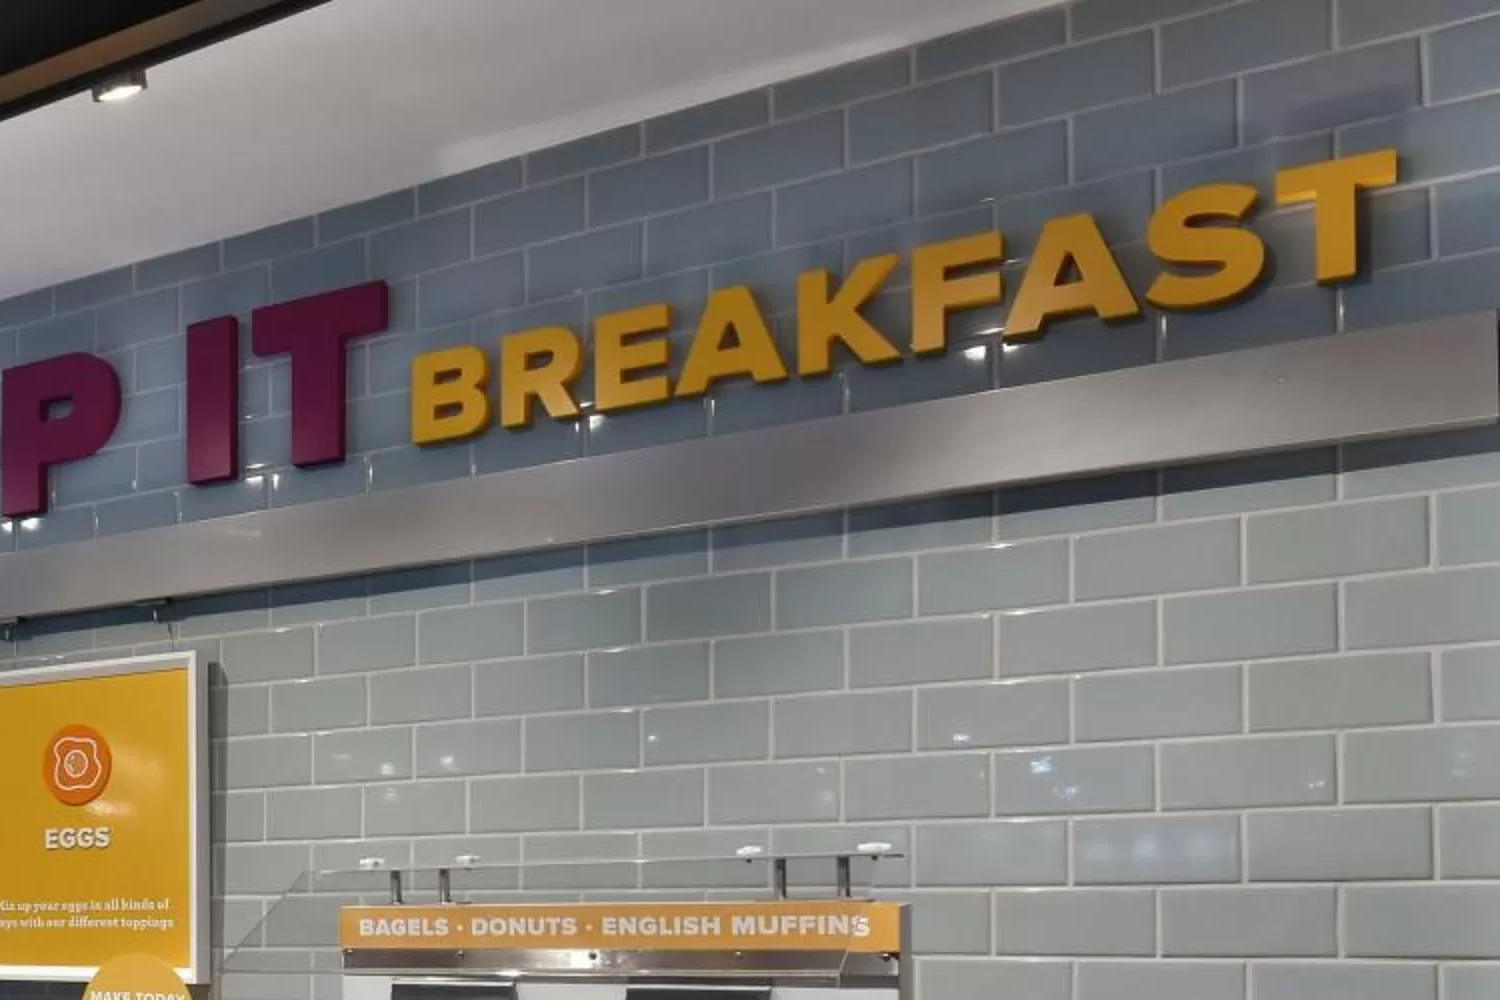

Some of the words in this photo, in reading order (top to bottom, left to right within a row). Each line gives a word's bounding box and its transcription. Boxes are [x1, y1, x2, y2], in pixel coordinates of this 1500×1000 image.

[186, 279, 390, 485] IT
[411, 149, 1397, 446] BREAKFAST
[45, 827, 111, 849] EGGS
[31, 902, 60, 914] your
[61, 902, 88, 914] eggs
[103, 898, 119, 911] all
[121, 898, 155, 911] kinds
[158, 897, 170, 910] of
[19, 916, 45, 928] with
[67, 915, 119, 928] different
[121, 916, 174, 931] toppings
[359, 916, 449, 937] BAGELS
[472, 916, 578, 937] DONUTS
[602, 915, 721, 936] ENGLISH
[731, 914, 871, 937] MUFFINS
